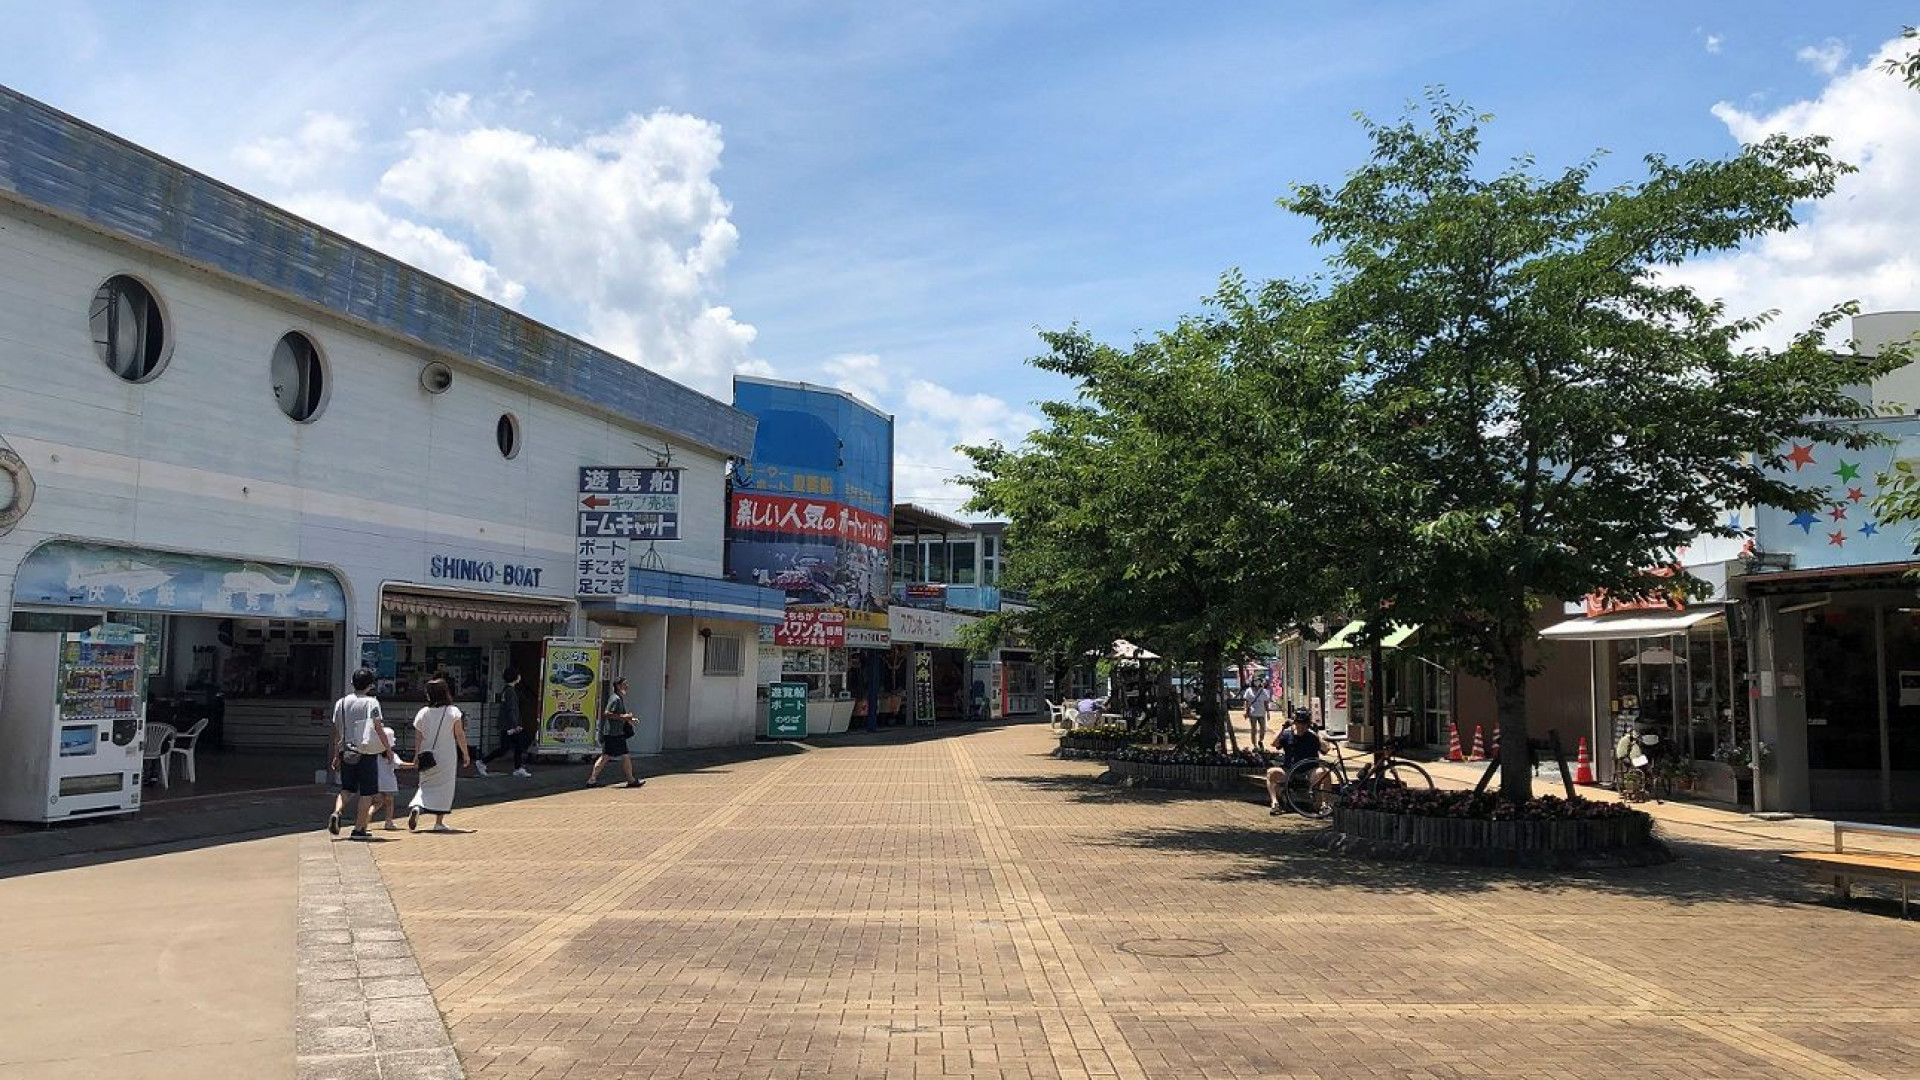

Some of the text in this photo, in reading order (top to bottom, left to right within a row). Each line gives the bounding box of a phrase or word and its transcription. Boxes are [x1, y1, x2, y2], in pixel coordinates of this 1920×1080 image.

[585, 469, 675, 492] 遊覧船
[580, 512, 676, 536] トムキャット
[579, 539, 626, 556] ボート
[578, 560, 626, 575] 手こぎ
[578, 579, 625, 594] 足こぎ
[1333, 658, 1347, 709] KIRIN
[771, 687, 806, 699] 遊覧船
[771, 700, 805, 711] ボート
